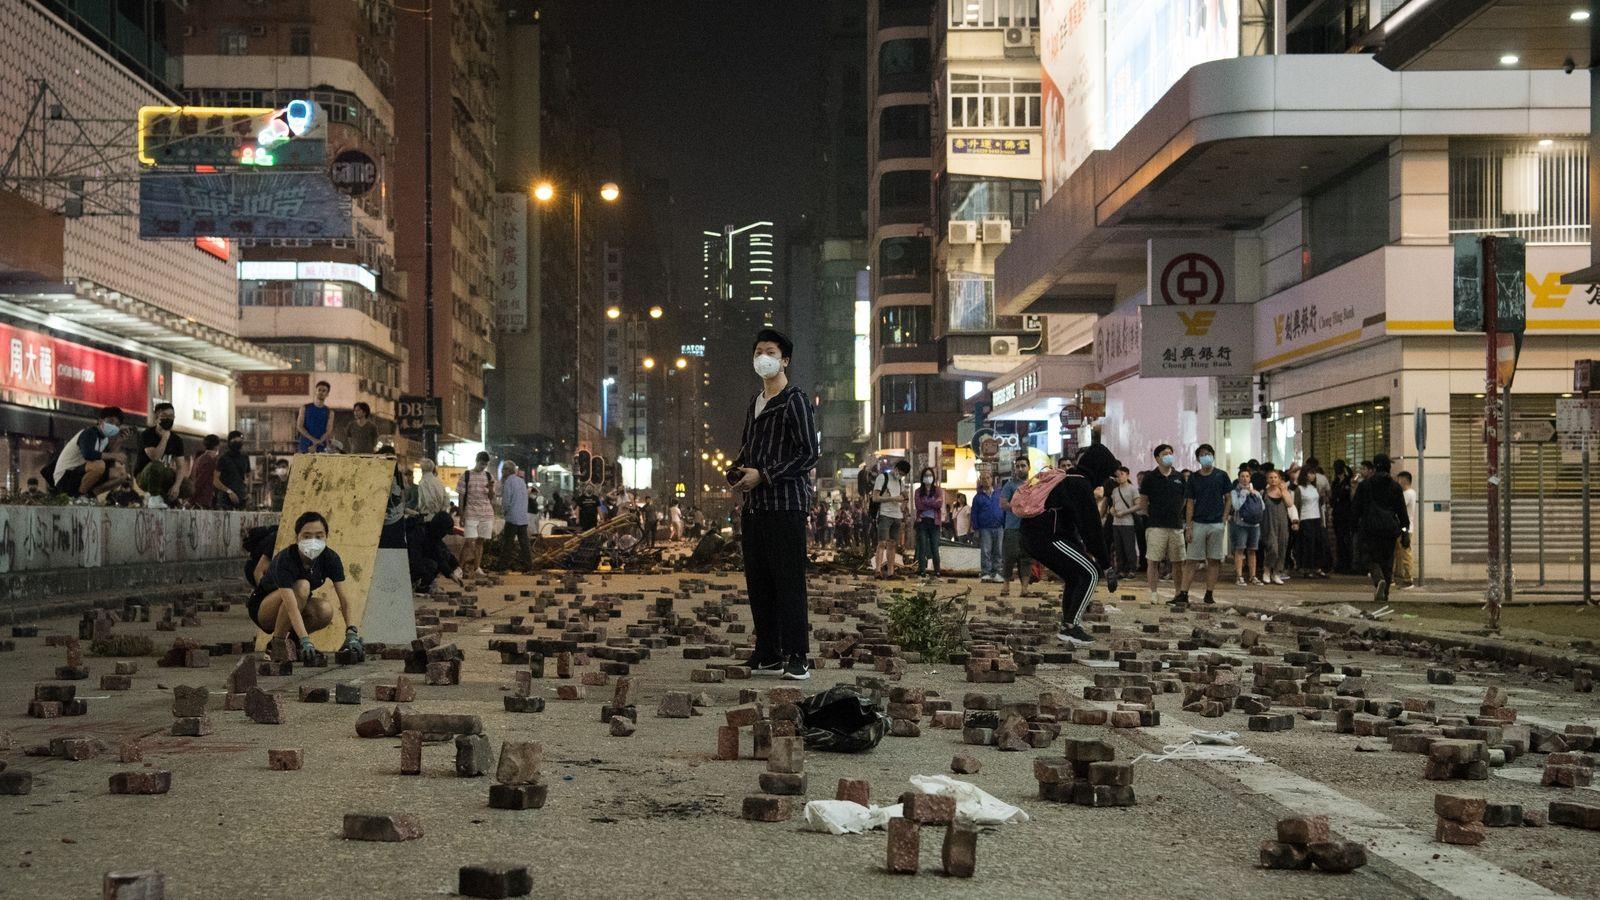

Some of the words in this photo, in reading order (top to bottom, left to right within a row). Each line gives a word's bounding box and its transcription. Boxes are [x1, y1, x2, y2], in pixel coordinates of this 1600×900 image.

[1343, 304, 1355, 320] Bank
[1285, 304, 1317, 341] 創興銀行
[10, 338, 53, 385] 周大福
[1163, 346, 1232, 361] 創興銀行
[1162, 362, 1187, 370] Chong
